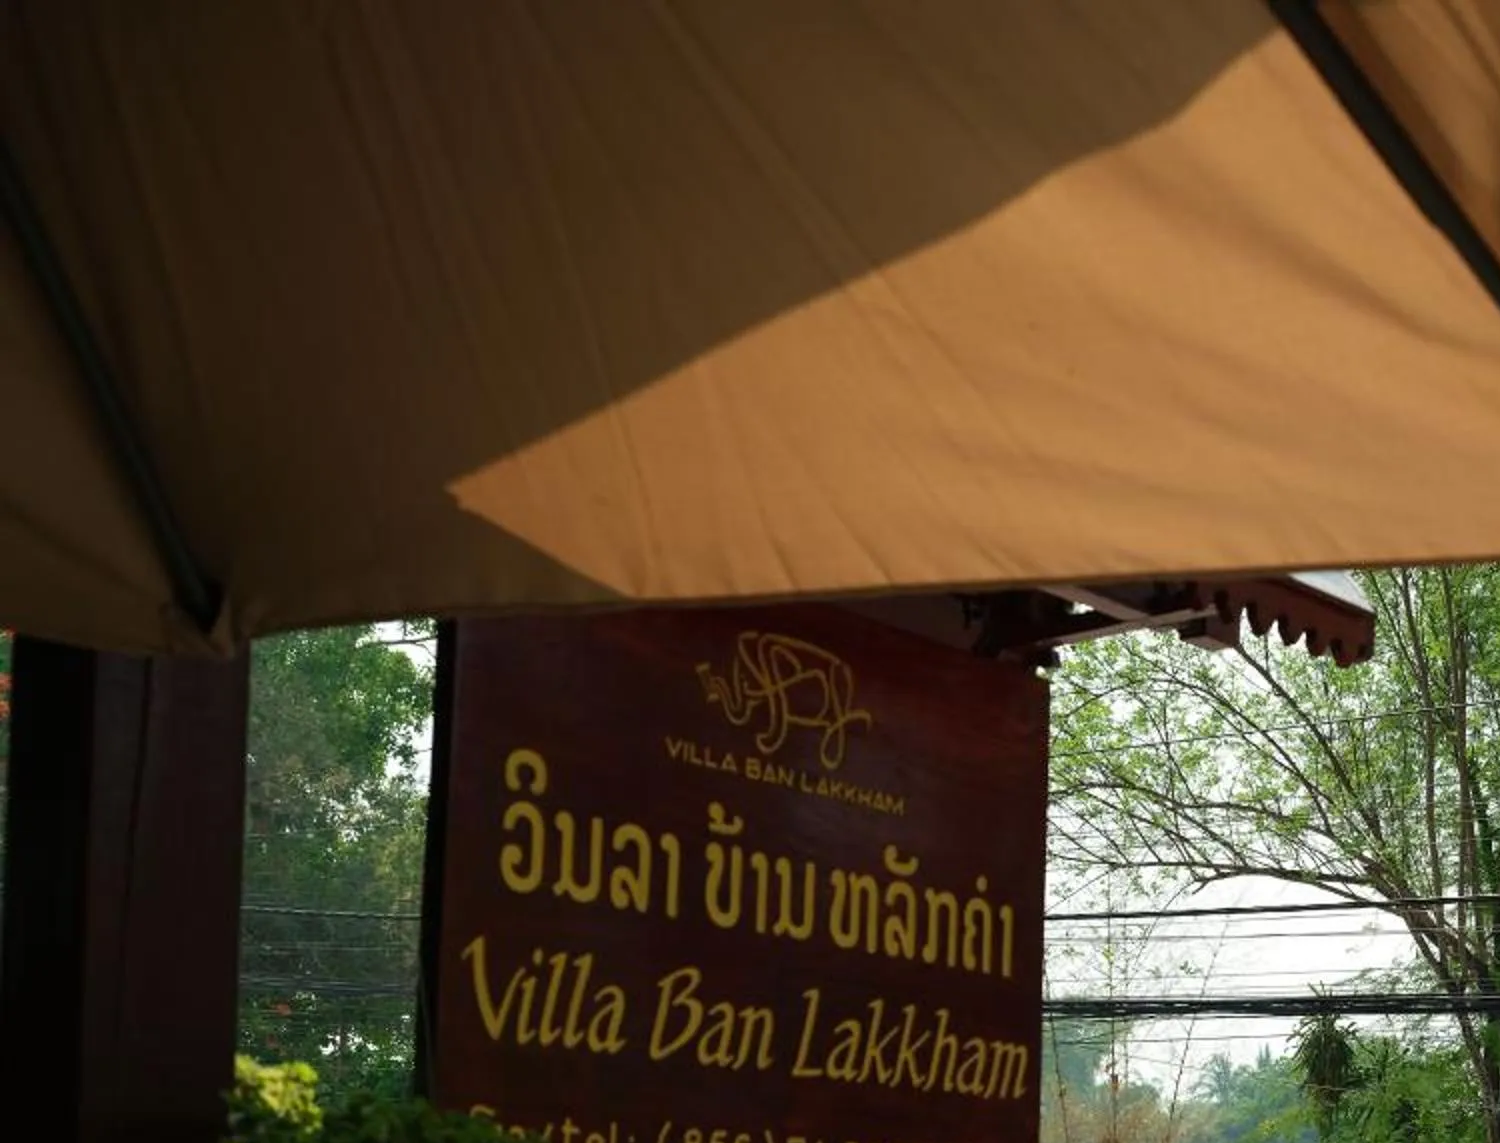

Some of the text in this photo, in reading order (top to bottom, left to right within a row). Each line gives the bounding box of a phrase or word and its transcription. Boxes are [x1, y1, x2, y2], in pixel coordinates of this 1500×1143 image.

[663, 735, 906, 817] VILLA BAN LAKKHAM
[460, 934, 1029, 1100] Villa Ban Lakkham
